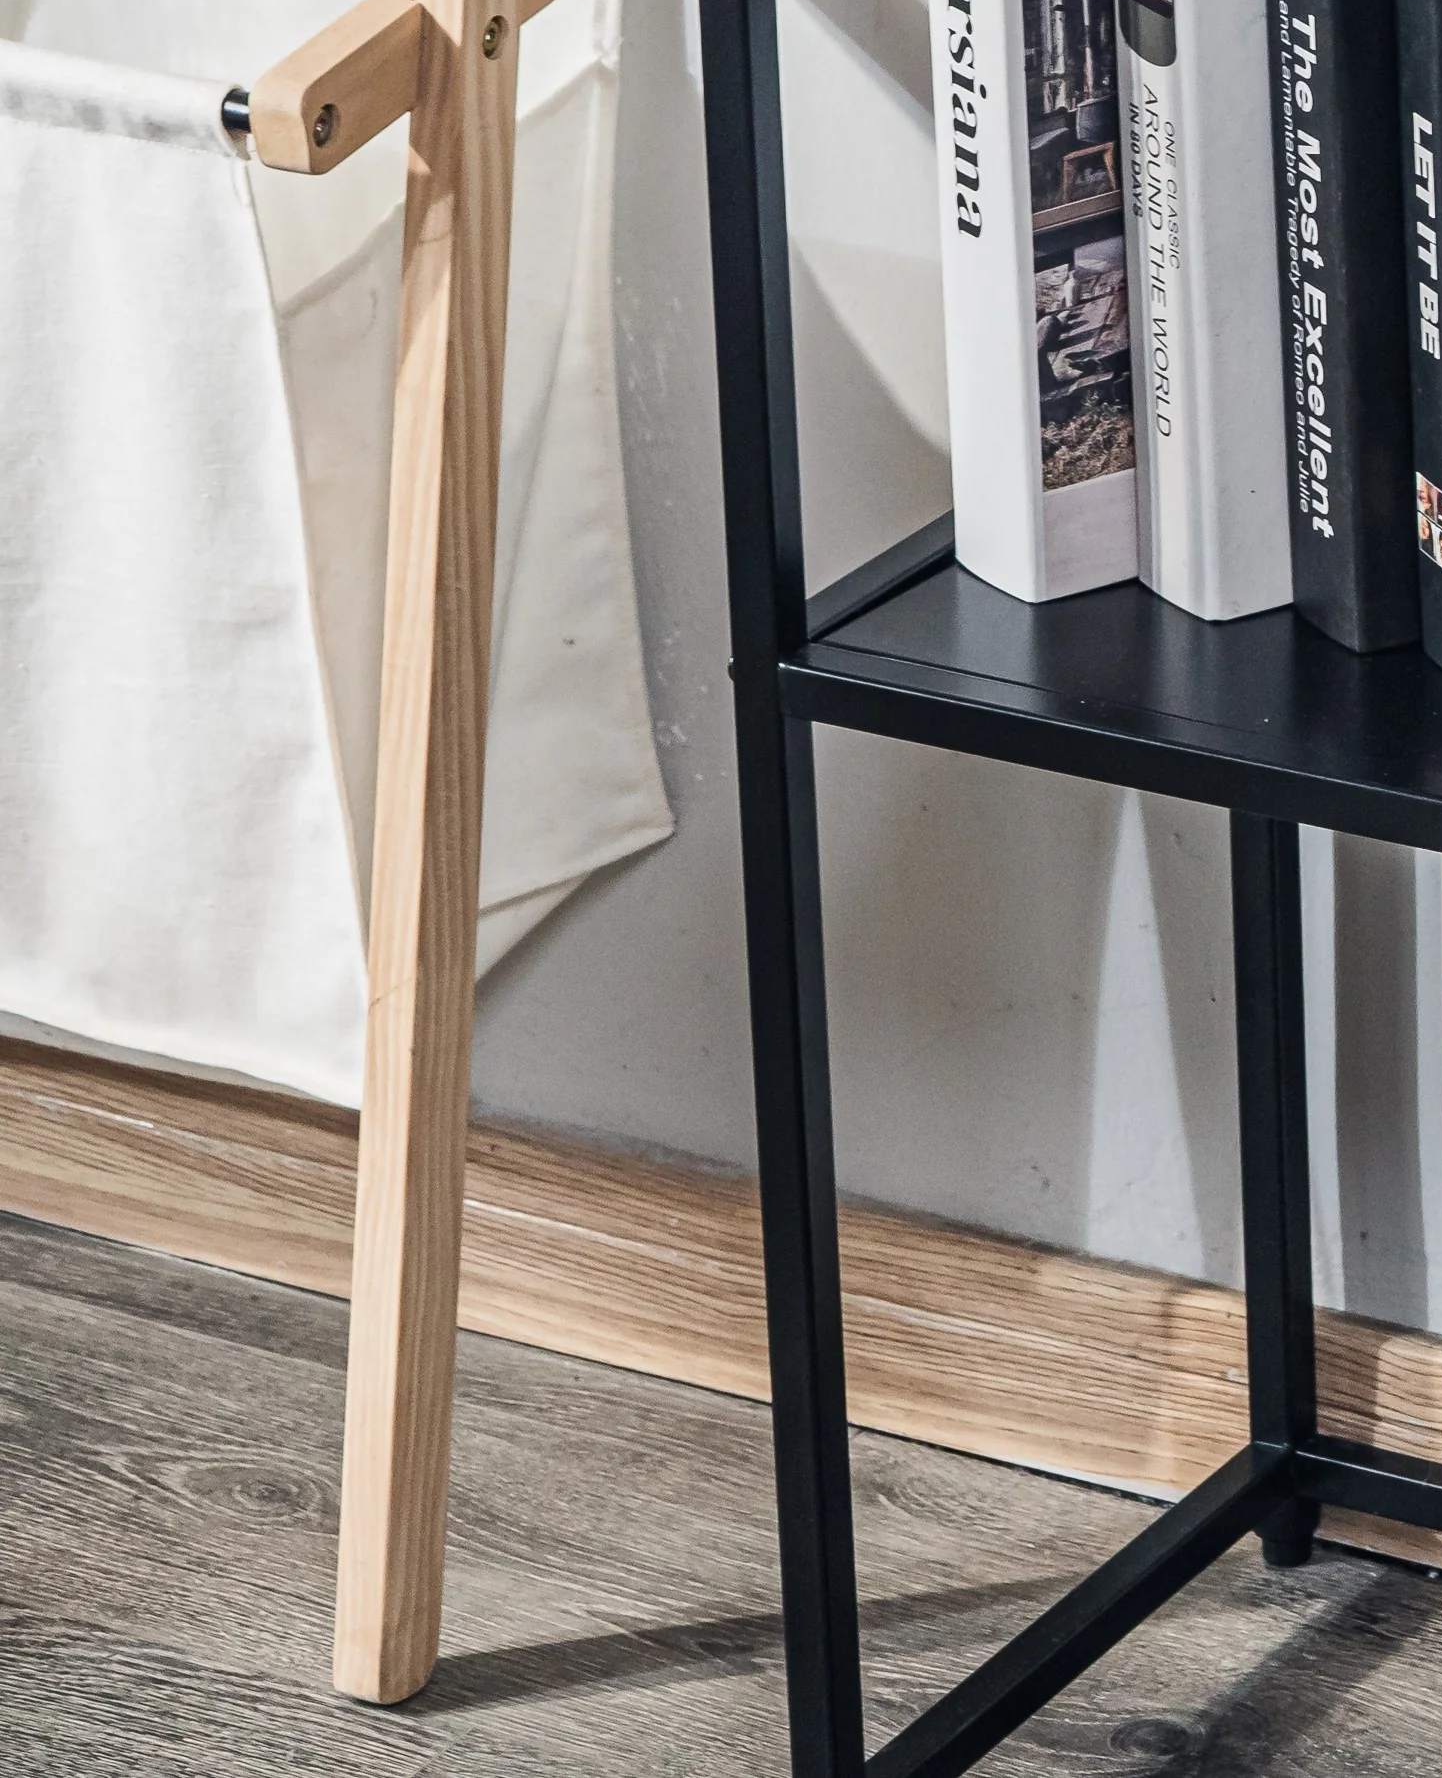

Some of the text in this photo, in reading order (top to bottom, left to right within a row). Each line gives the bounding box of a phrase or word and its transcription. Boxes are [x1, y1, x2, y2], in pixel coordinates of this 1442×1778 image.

[1278, 0, 1293, 46] and
[1129, 101, 1141, 125] IN
[1280, 52, 1297, 188] Lamentable
[1130, 158, 1145, 219] DAYS
[1164, 120, 1182, 270] ONE CLASSIC
[1142, 82, 1172, 438] AROUND THE WORLD
[1286, 195, 1303, 289] Tragedy
[1292, 13, 1336, 539] The Most Excellent
[1412, 111, 1442, 360] LET IT BE
[1291, 296, 1304, 321] of
[1291, 322, 1305, 406] Romeo
[1295, 410, 1309, 456] and
